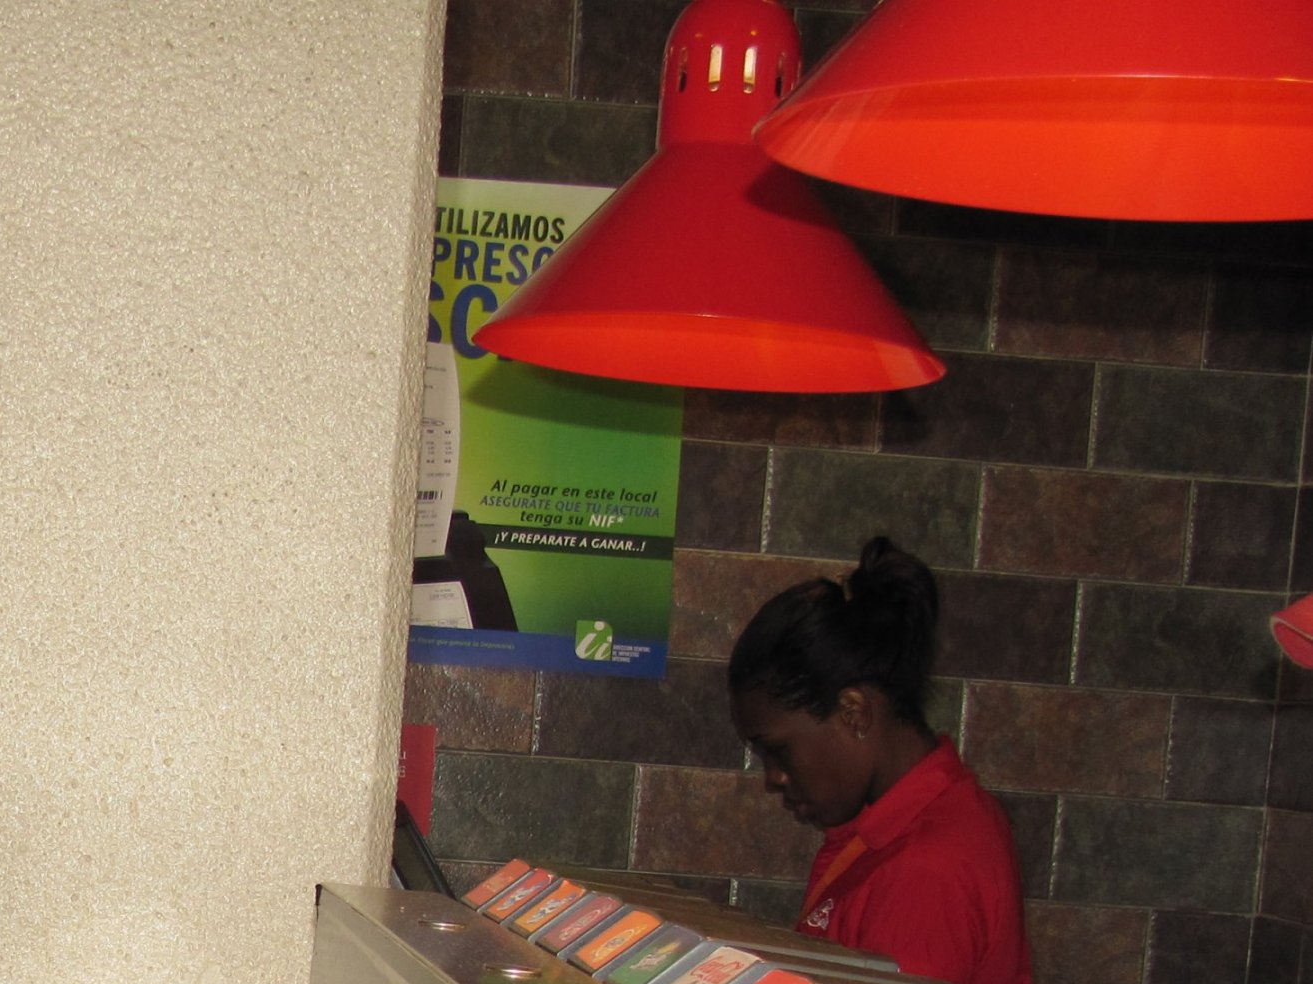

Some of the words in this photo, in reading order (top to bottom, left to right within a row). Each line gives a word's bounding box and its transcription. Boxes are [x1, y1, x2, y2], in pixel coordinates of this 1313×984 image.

[491, 480, 507, 493] Al
[510, 484, 557, 498] pagar
[562, 487, 580, 497] en
[585, 489, 615, 500] este
[620, 488, 657, 503] local
[555, 501, 581, 513] QUE
[586, 503, 602, 514] TU
[605, 504, 660, 518] FACTURA
[520, 511, 562, 527] tenga
[568, 515, 584, 526] su
[511, 533, 576, 547] PREPARATE
[579, 537, 587, 548] A
